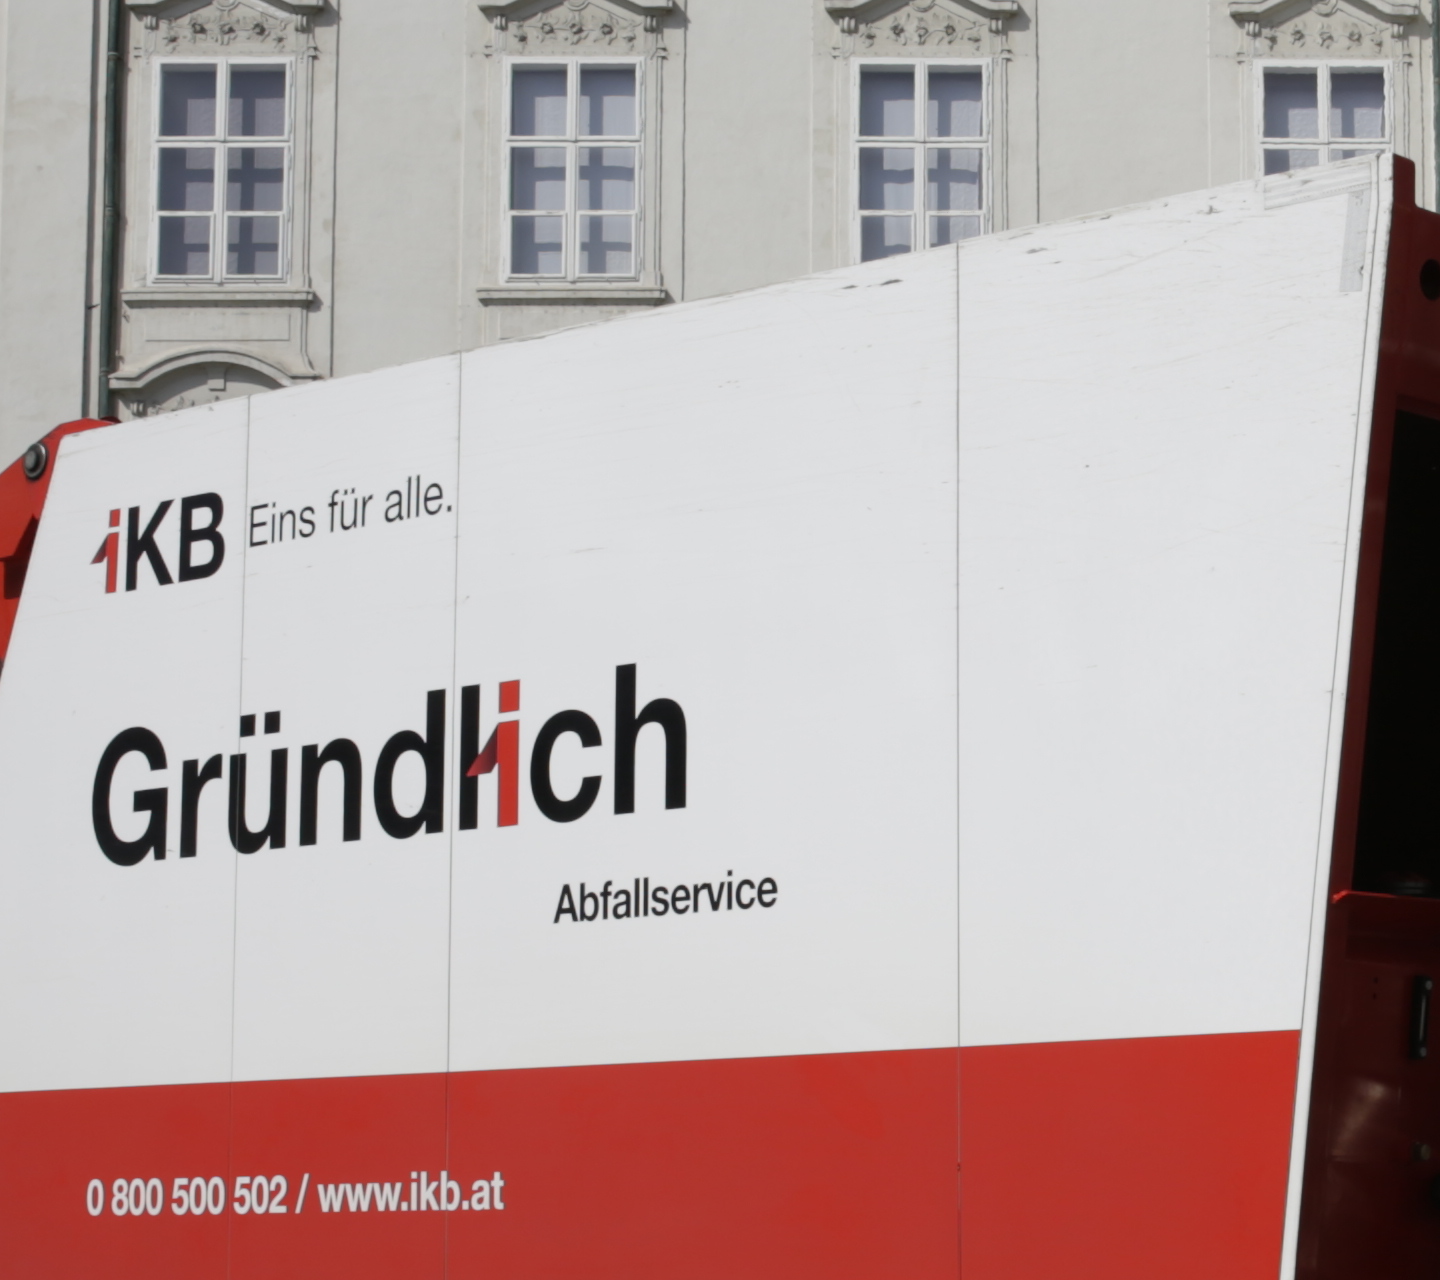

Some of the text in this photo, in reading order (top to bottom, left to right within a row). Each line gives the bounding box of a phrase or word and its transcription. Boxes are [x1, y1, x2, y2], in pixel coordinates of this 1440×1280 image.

[249, 501, 316, 548] Eins
[328, 488, 374, 534] für
[384, 475, 453, 523] alle.
[91, 662, 687, 867] Gründlich
[553, 870, 778, 924] Abfallservice
[86, 1178, 105, 1216] 0
[110, 1178, 164, 1216] 800
[170, 1176, 226, 1216] 500
[233, 1174, 288, 1214] 502
[317, 1170, 505, 1213] www.ikb.at
